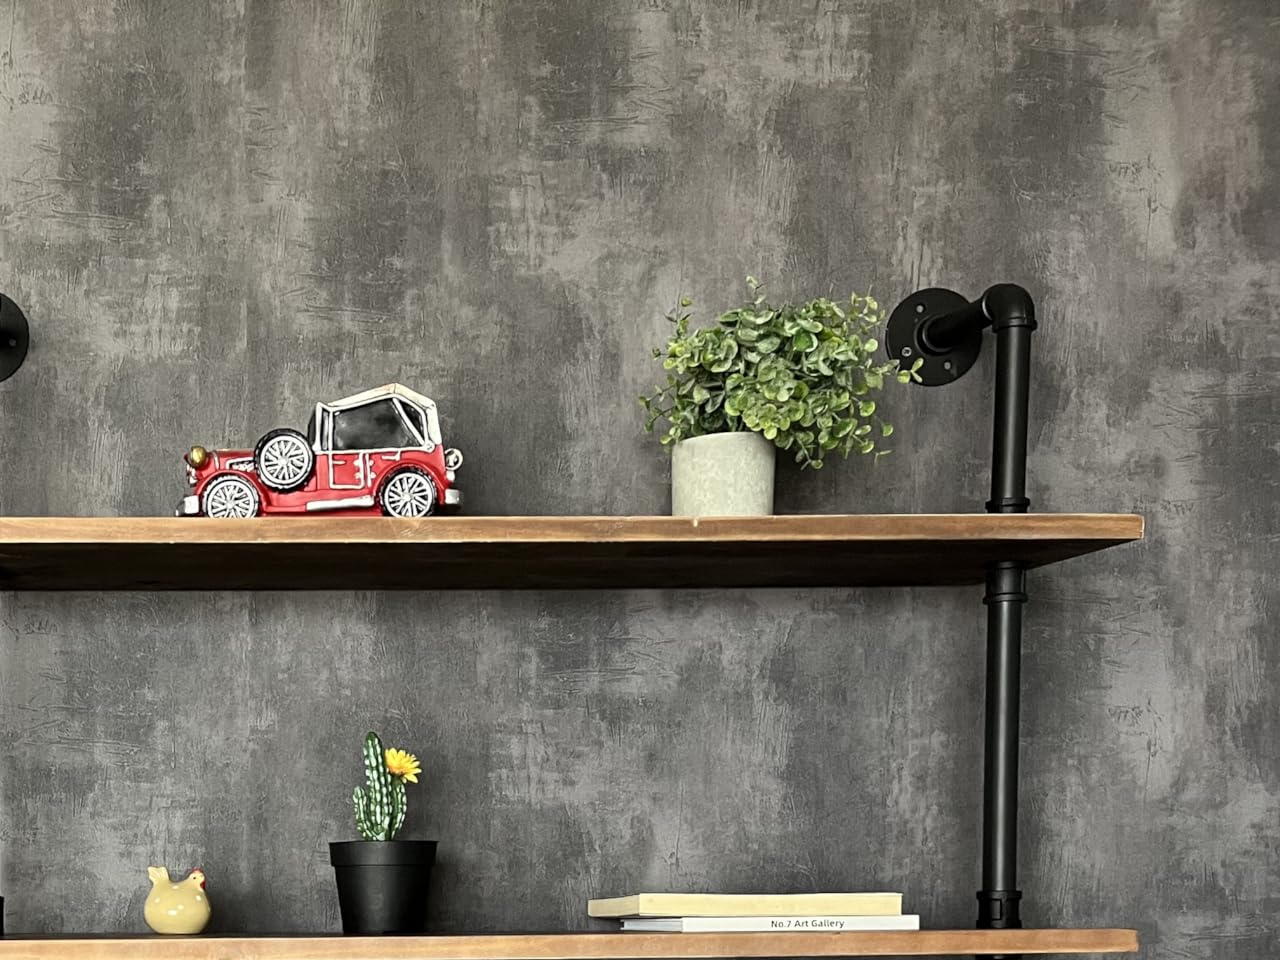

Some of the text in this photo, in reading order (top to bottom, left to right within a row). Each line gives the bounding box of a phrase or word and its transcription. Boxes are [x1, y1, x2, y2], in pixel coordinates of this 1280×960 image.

[770, 919, 845, 929] No.7 Art Gallery
